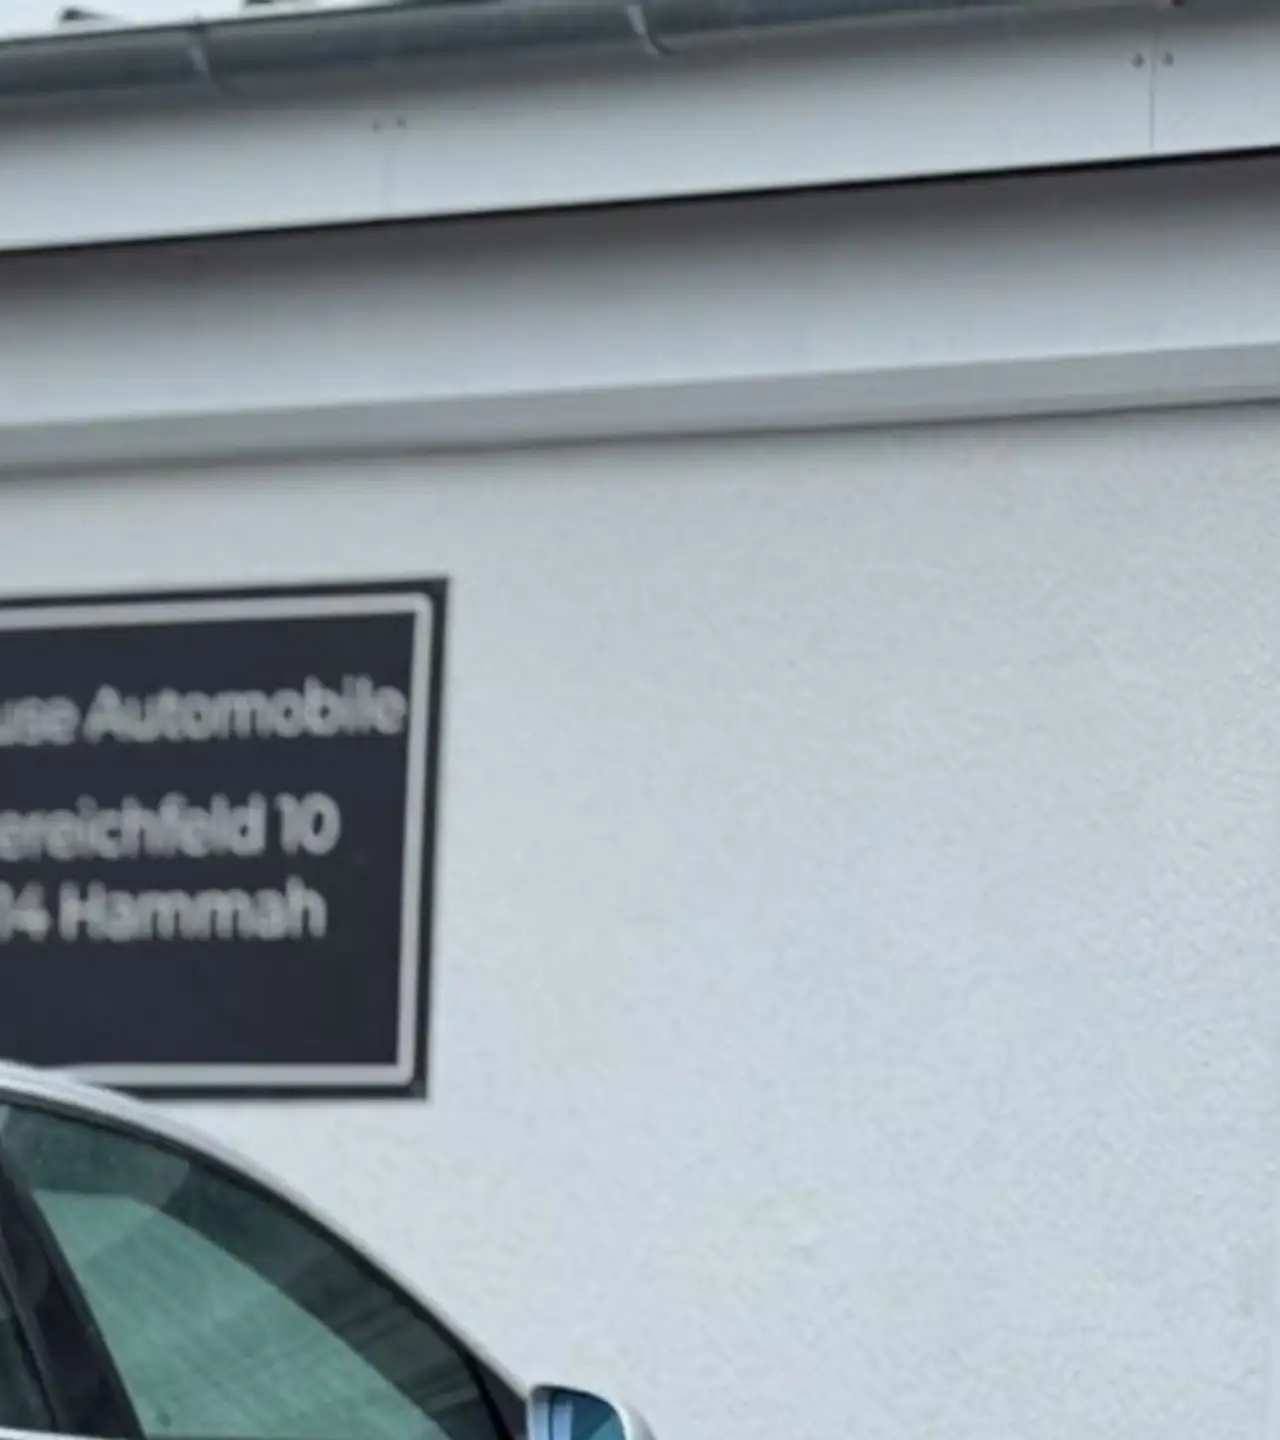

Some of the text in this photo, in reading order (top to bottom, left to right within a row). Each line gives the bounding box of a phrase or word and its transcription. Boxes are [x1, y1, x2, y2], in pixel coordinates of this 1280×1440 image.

[82, 675, 407, 743] Automobile
[274, 791, 341, 856] 10
[57, 873, 328, 942] Hammah
